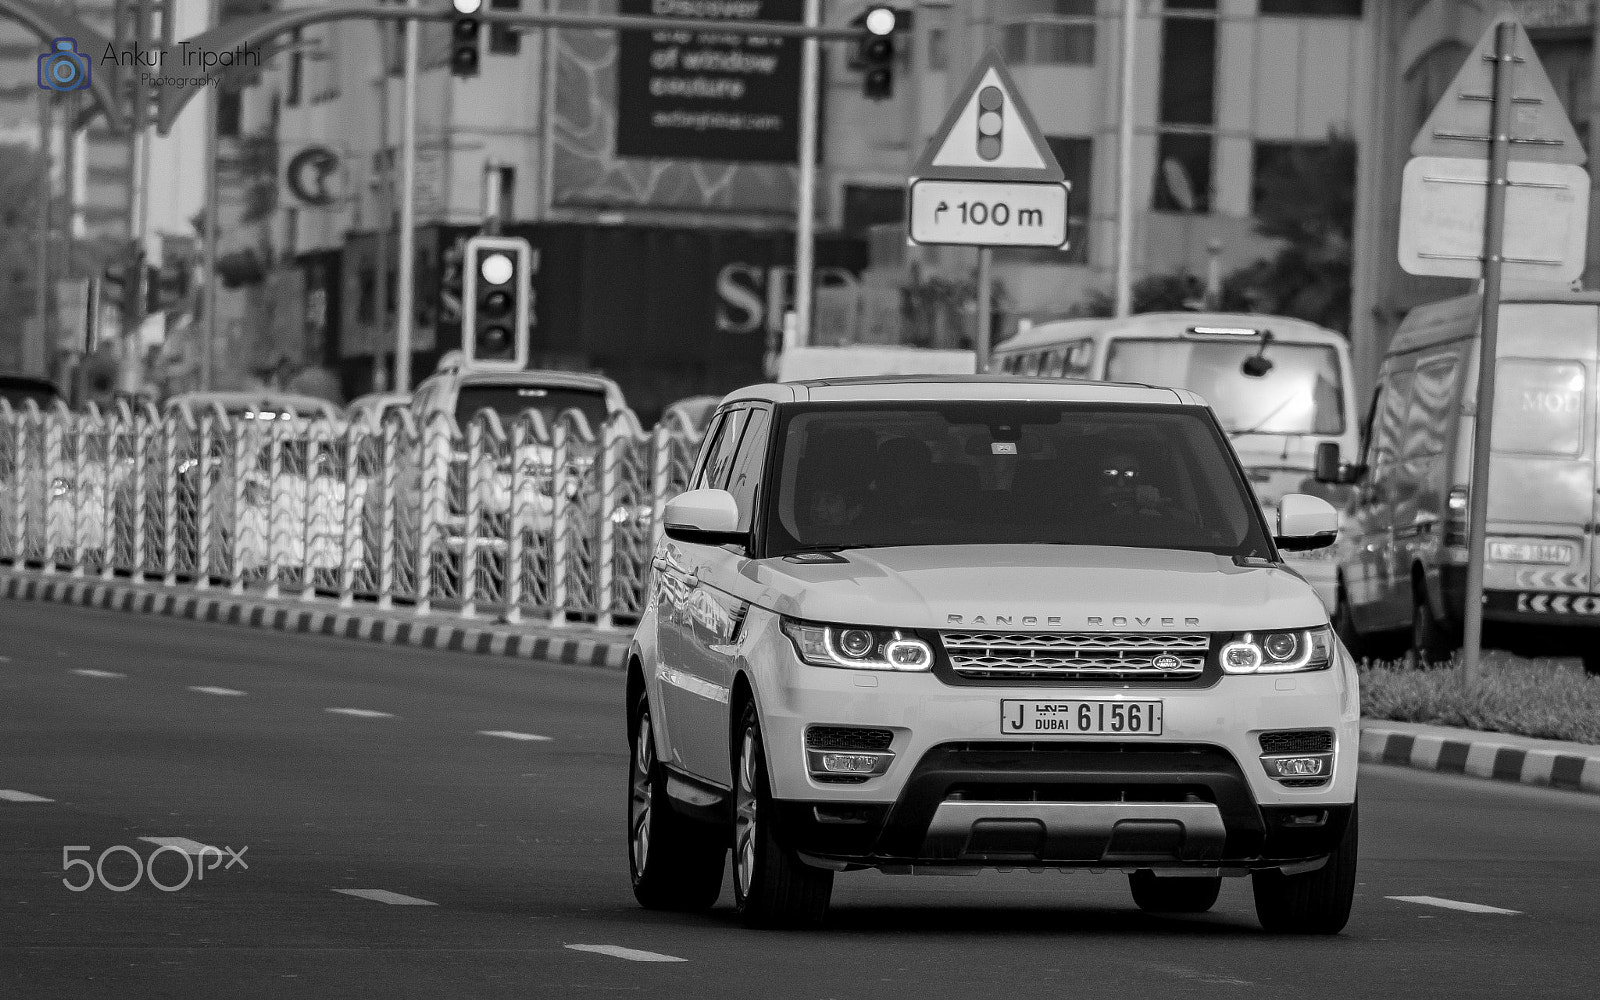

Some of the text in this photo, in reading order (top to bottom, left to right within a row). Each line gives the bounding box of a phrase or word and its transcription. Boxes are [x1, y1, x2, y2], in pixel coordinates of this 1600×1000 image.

[650, 48, 777, 73] of window
[957, 202, 1010, 226] 100
[1018, 208, 1043, 227] m
[947, 614, 1201, 627] RANGE ROVER
[1012, 703, 1154, 732] J 61561
[1035, 704, 1069, 716] دبي
[1035, 719, 1069, 730] DUBAI
